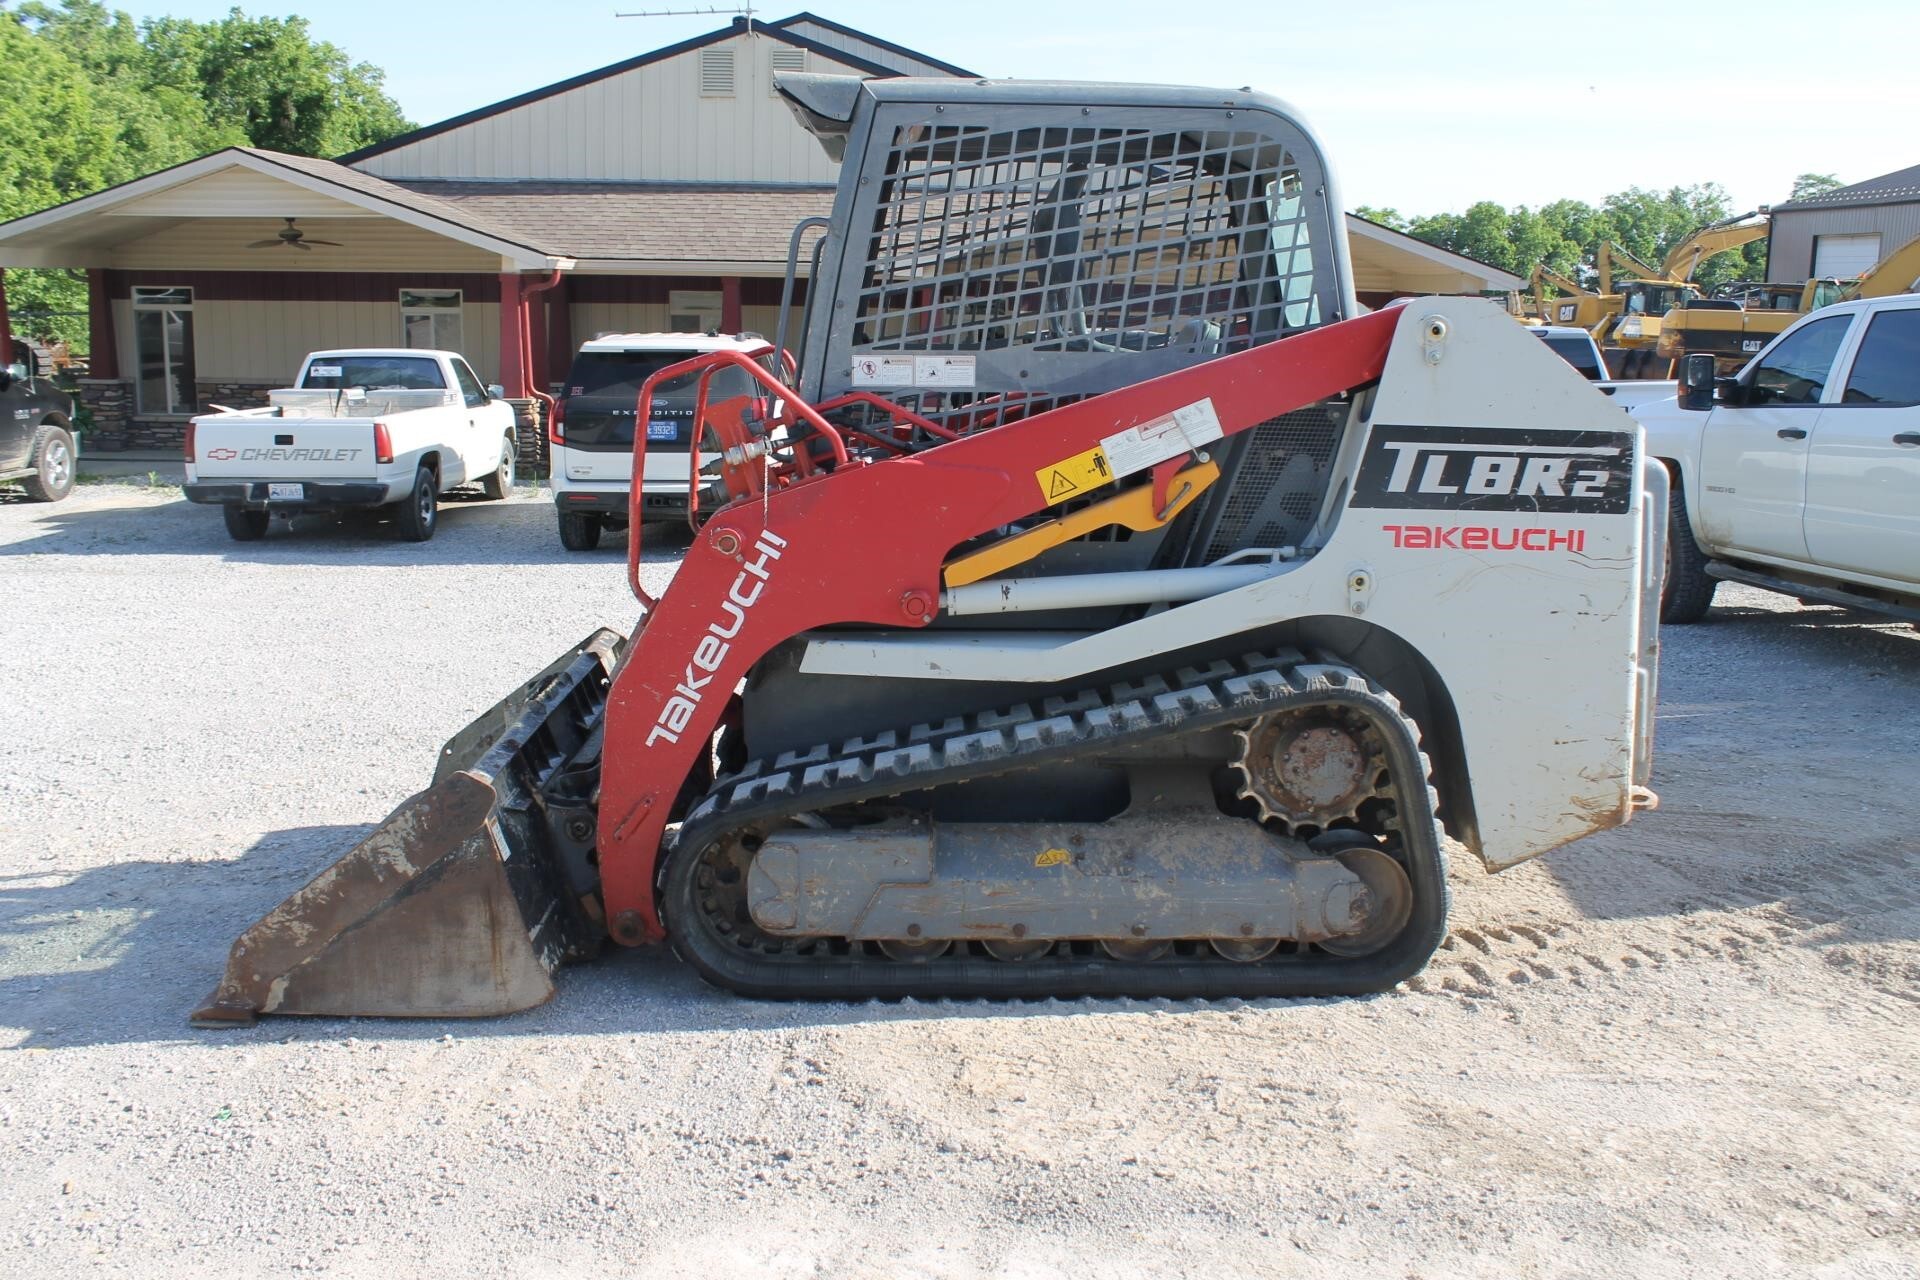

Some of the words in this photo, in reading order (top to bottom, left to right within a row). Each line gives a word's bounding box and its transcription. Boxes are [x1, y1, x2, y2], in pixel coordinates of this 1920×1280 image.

[1559, 305, 1575, 321] CAT
[1742, 340, 1762, 352] CAT
[240, 449, 362, 461] CHEVROLET
[1383, 441, 1620, 498] TL8R2
